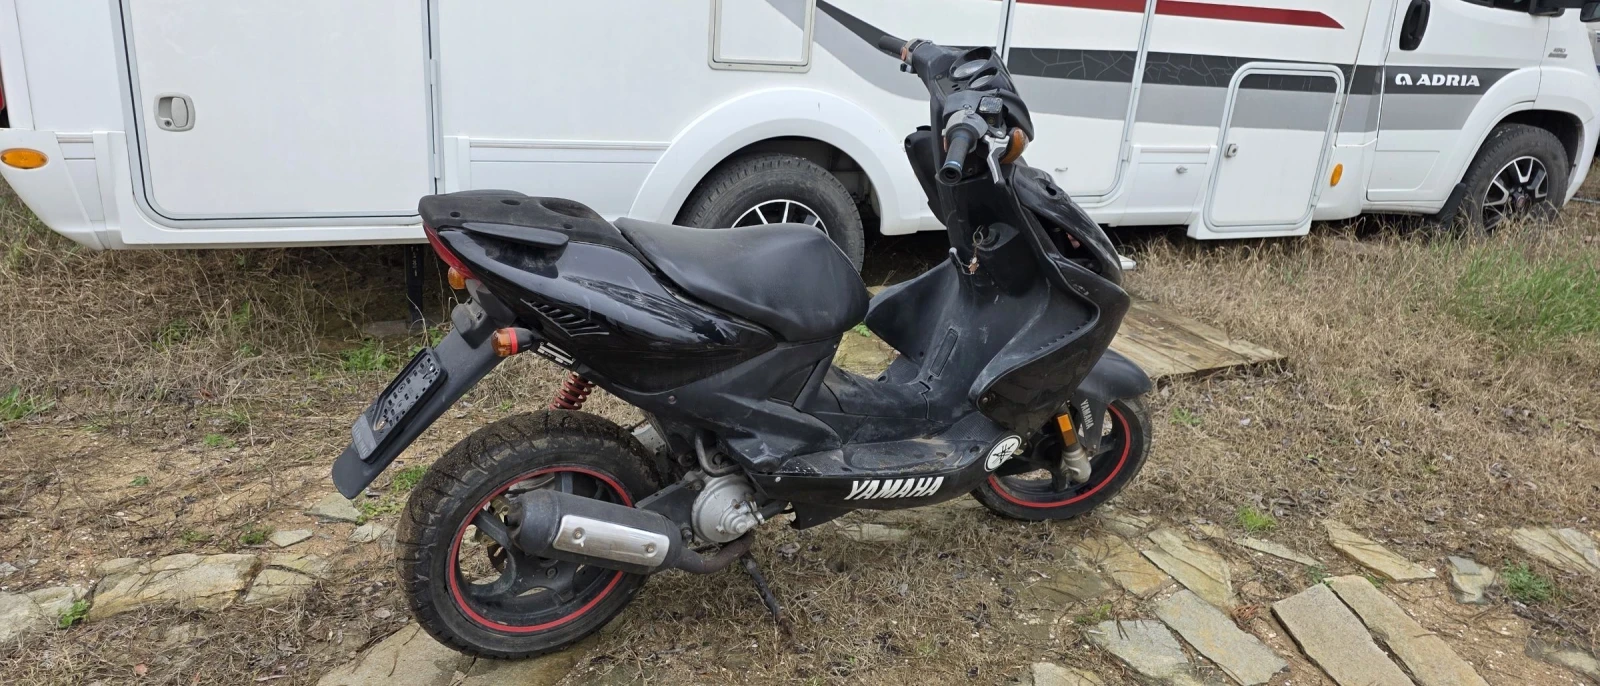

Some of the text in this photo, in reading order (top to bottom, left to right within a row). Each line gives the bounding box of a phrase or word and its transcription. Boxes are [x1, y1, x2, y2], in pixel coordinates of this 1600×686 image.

[1416, 73, 1480, 87] ADRIA
[1080, 398, 1095, 430] YAMAHA
[844, 476, 945, 500] YAMAHA
